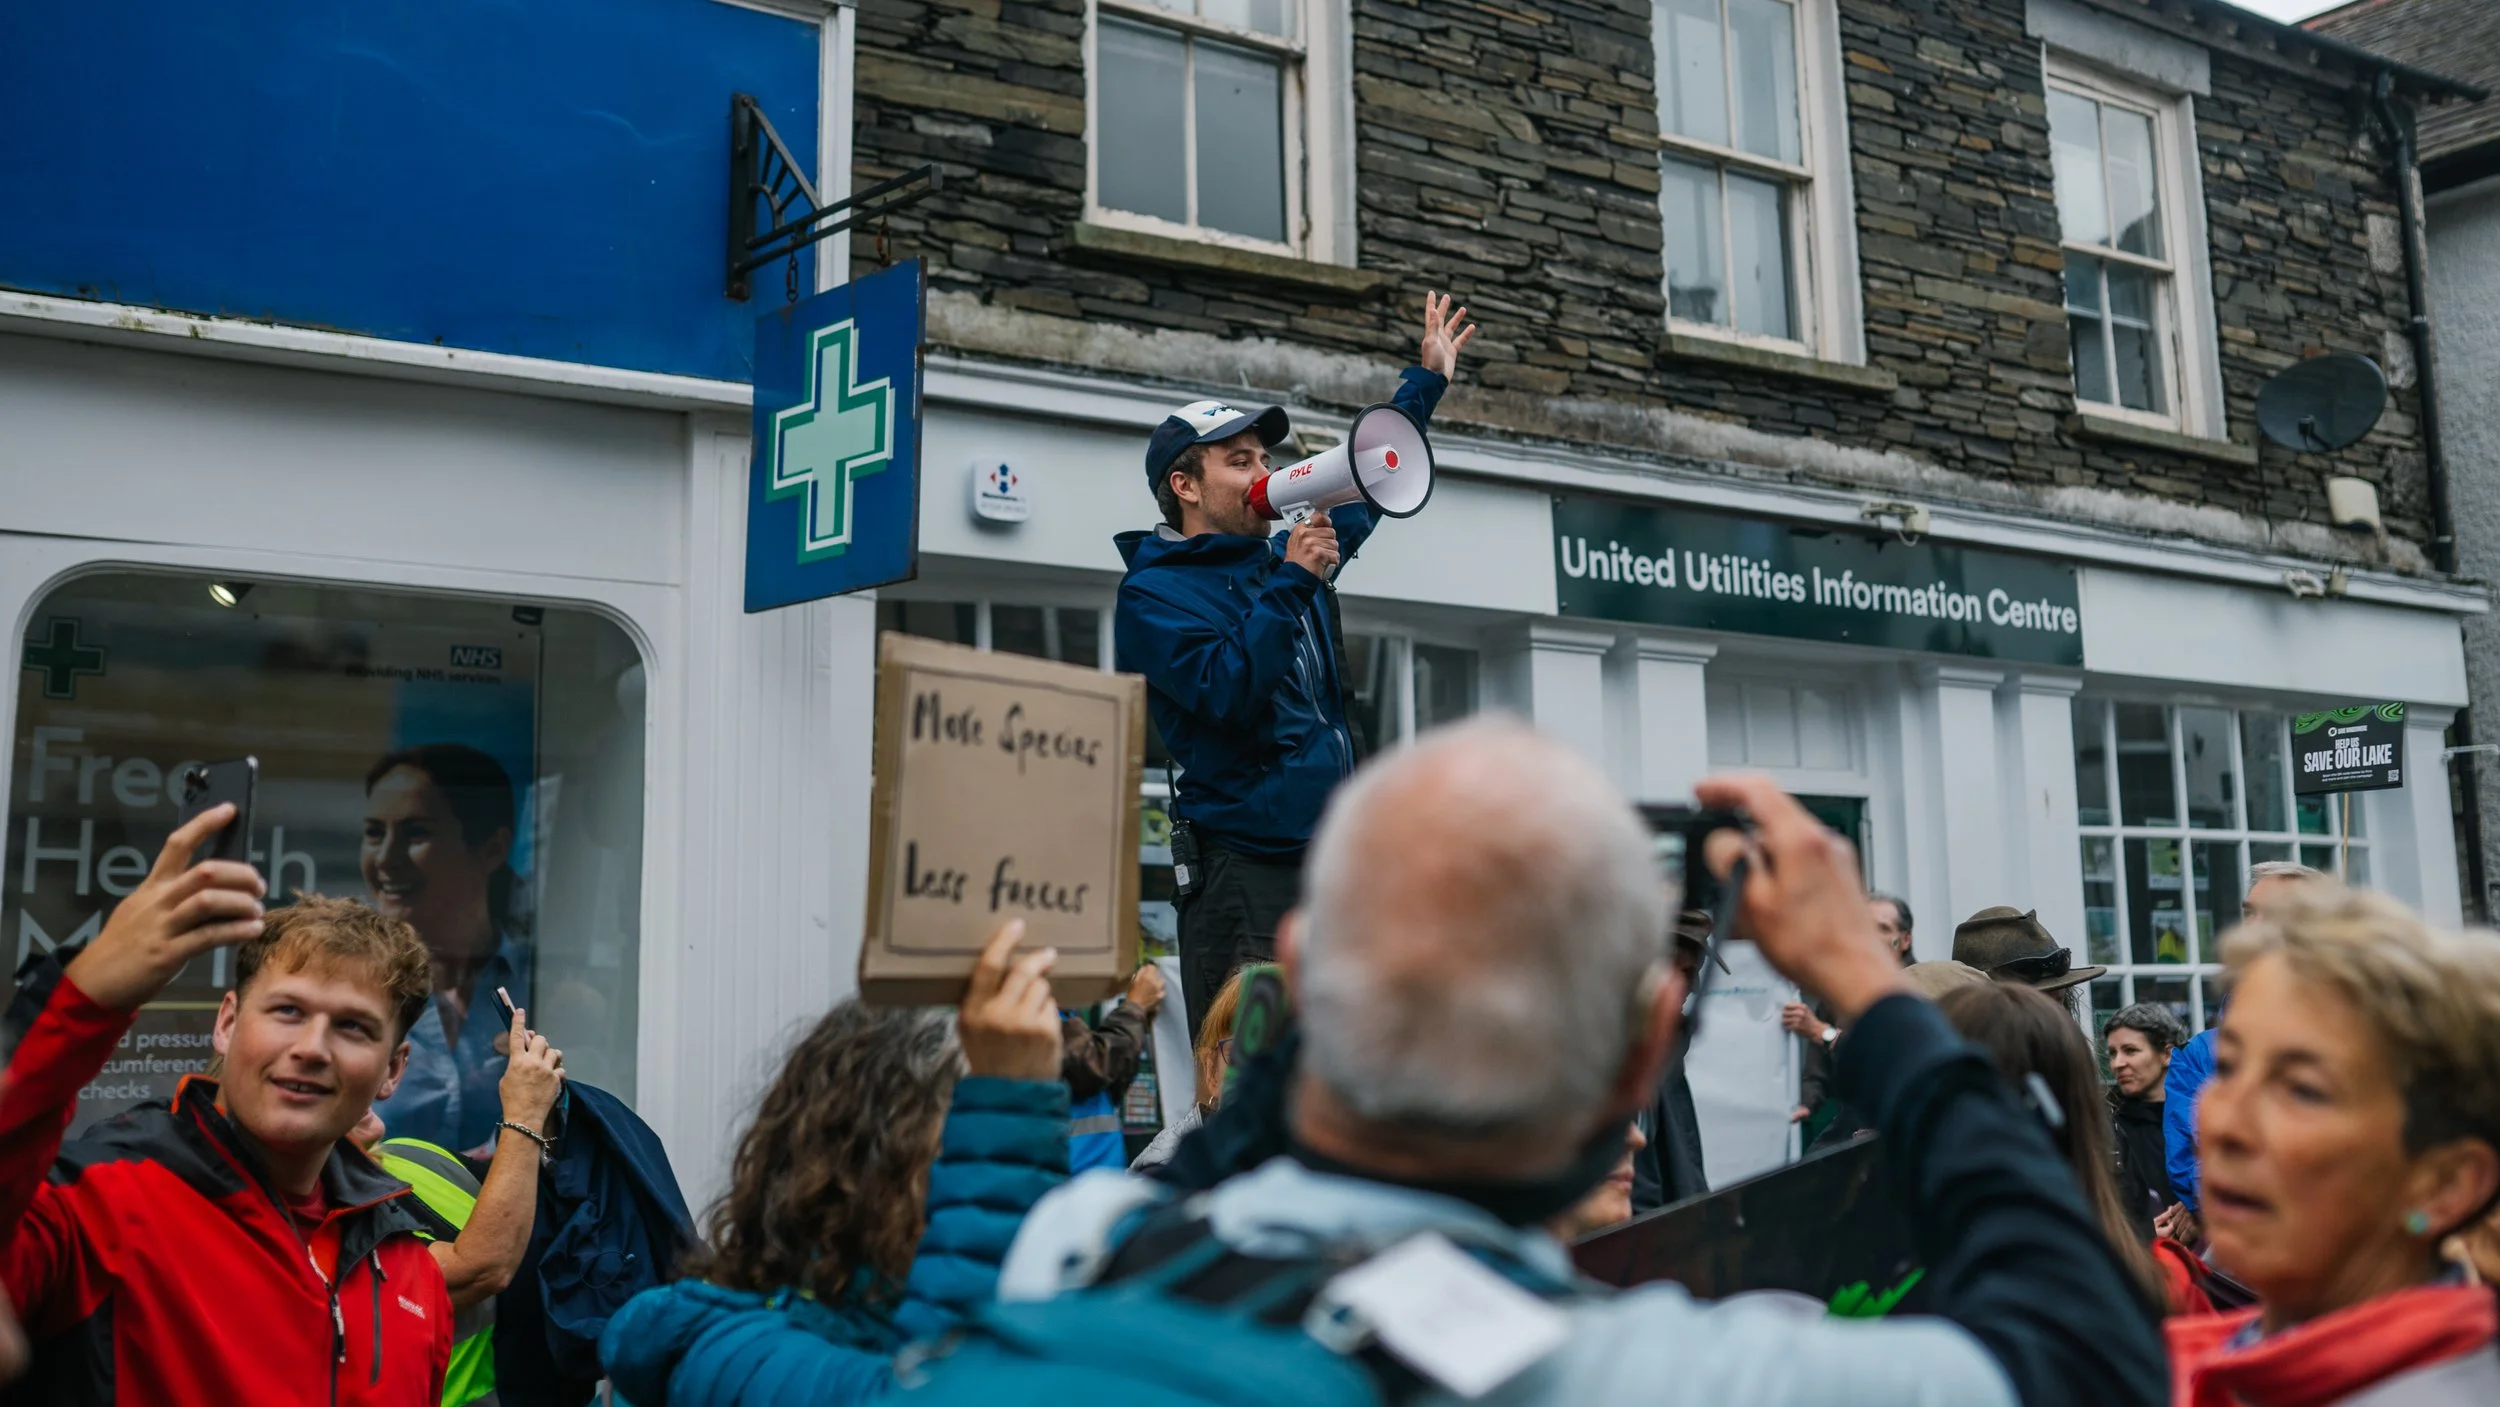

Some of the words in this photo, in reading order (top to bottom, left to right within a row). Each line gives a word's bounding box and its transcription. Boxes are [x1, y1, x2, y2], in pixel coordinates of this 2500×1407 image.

[1290, 463, 1313, 480] PYLE
[1561, 536, 1676, 588] United
[1684, 551, 1806, 602] Utilities
[1812, 566, 1982, 623] Information
[1987, 588, 2078, 634] Centre
[453, 647, 500, 667] NHS
[416, 668, 445, 681] NHS
[912, 690, 984, 746] More
[998, 701, 1102, 776] Species
[2335, 738, 2350, 750] HELP
[2351, 737, 2360, 748] US
[2303, 750, 2333, 772] SAVE
[2335, 748, 2360, 769] OUR
[2362, 743, 2392, 766] LAKE
[905, 839, 968, 904] Less
[136, 1029, 214, 1052] pressur
[101, 1054, 208, 1074] cumferenc
[78, 1079, 151, 1100] checks
